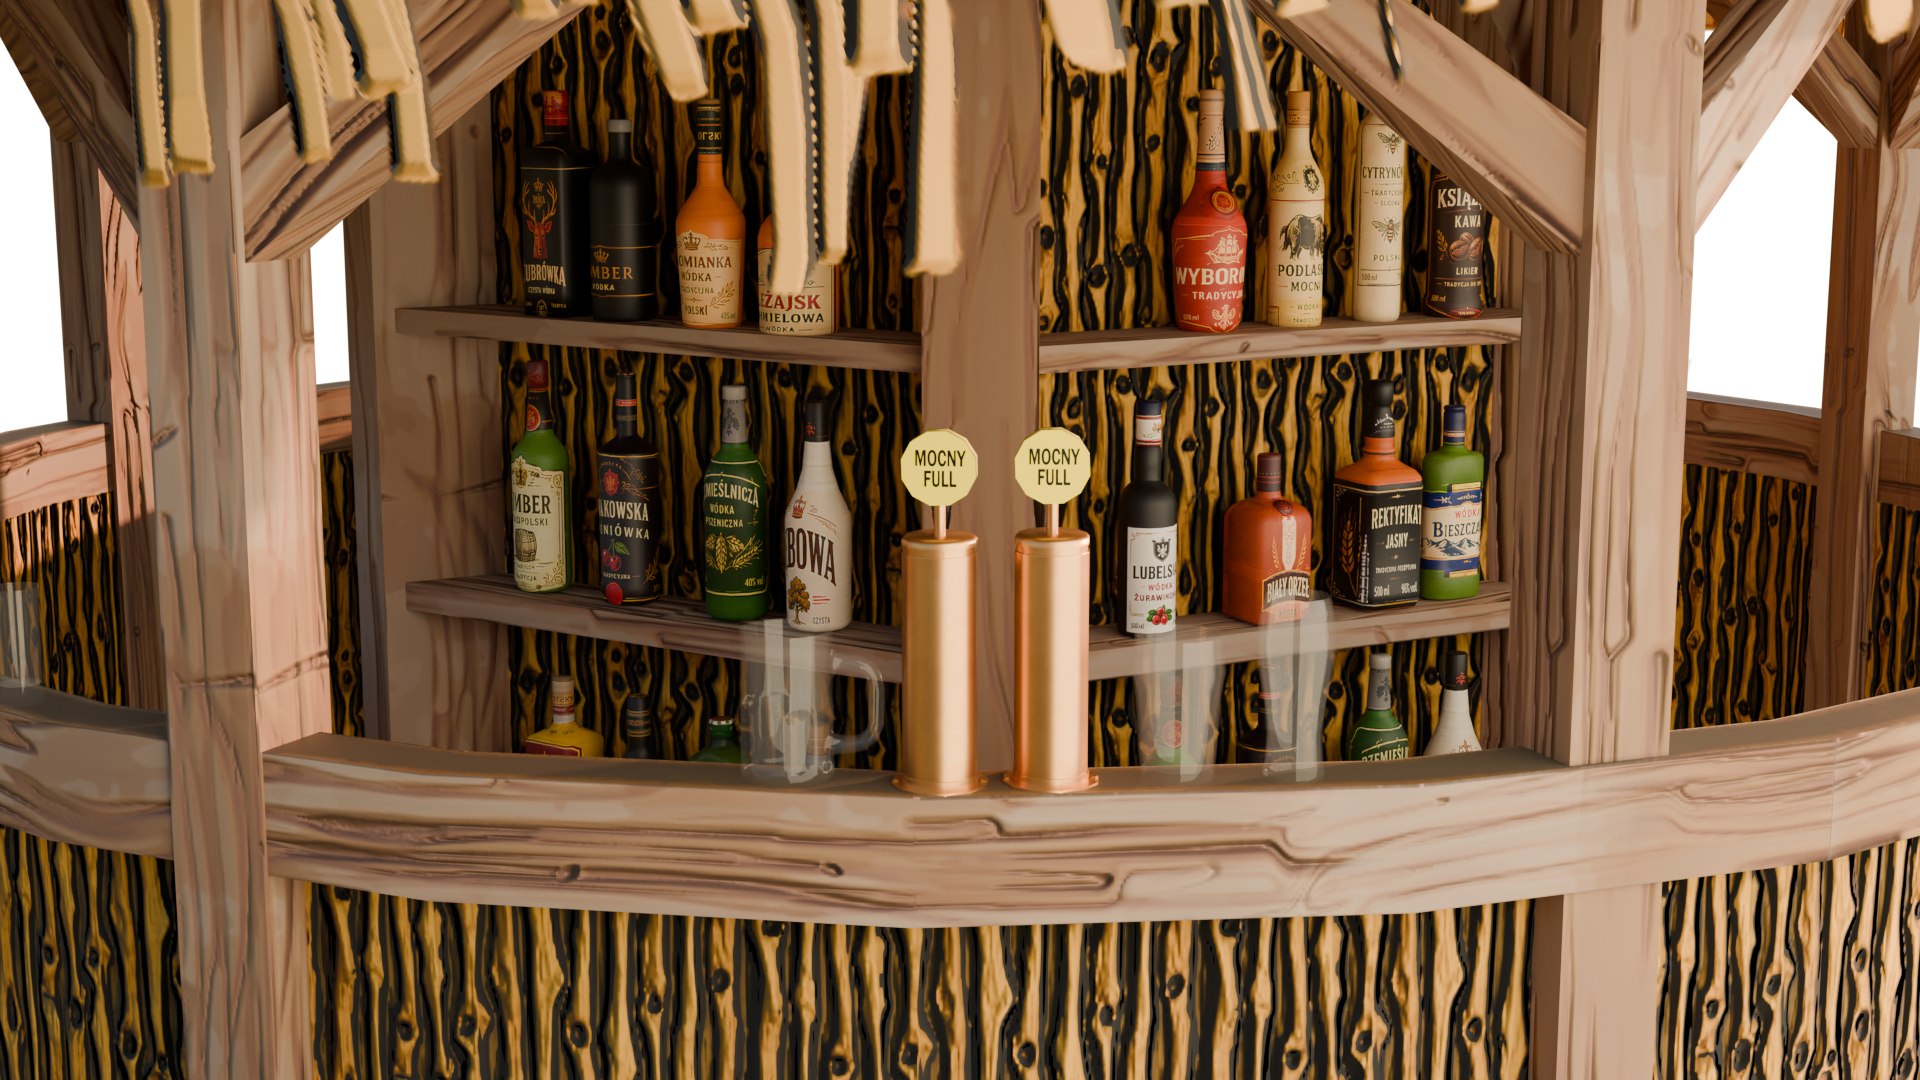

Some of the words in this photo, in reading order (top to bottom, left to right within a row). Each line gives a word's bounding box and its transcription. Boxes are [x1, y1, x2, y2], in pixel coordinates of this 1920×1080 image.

[524, 260, 567, 287] UBRÓWKA
[1456, 266, 1479, 276] LIKIER
[915, 449, 966, 467] MOCNY
[1029, 448, 1080, 465] MOCNY
[924, 470, 957, 487] FULL
[1038, 469, 1070, 485] FULL
[710, 502, 736, 515] WÓDKA
[1371, 503, 1422, 530] REKTYFIKAT
[1385, 532, 1409, 549] JASNY
